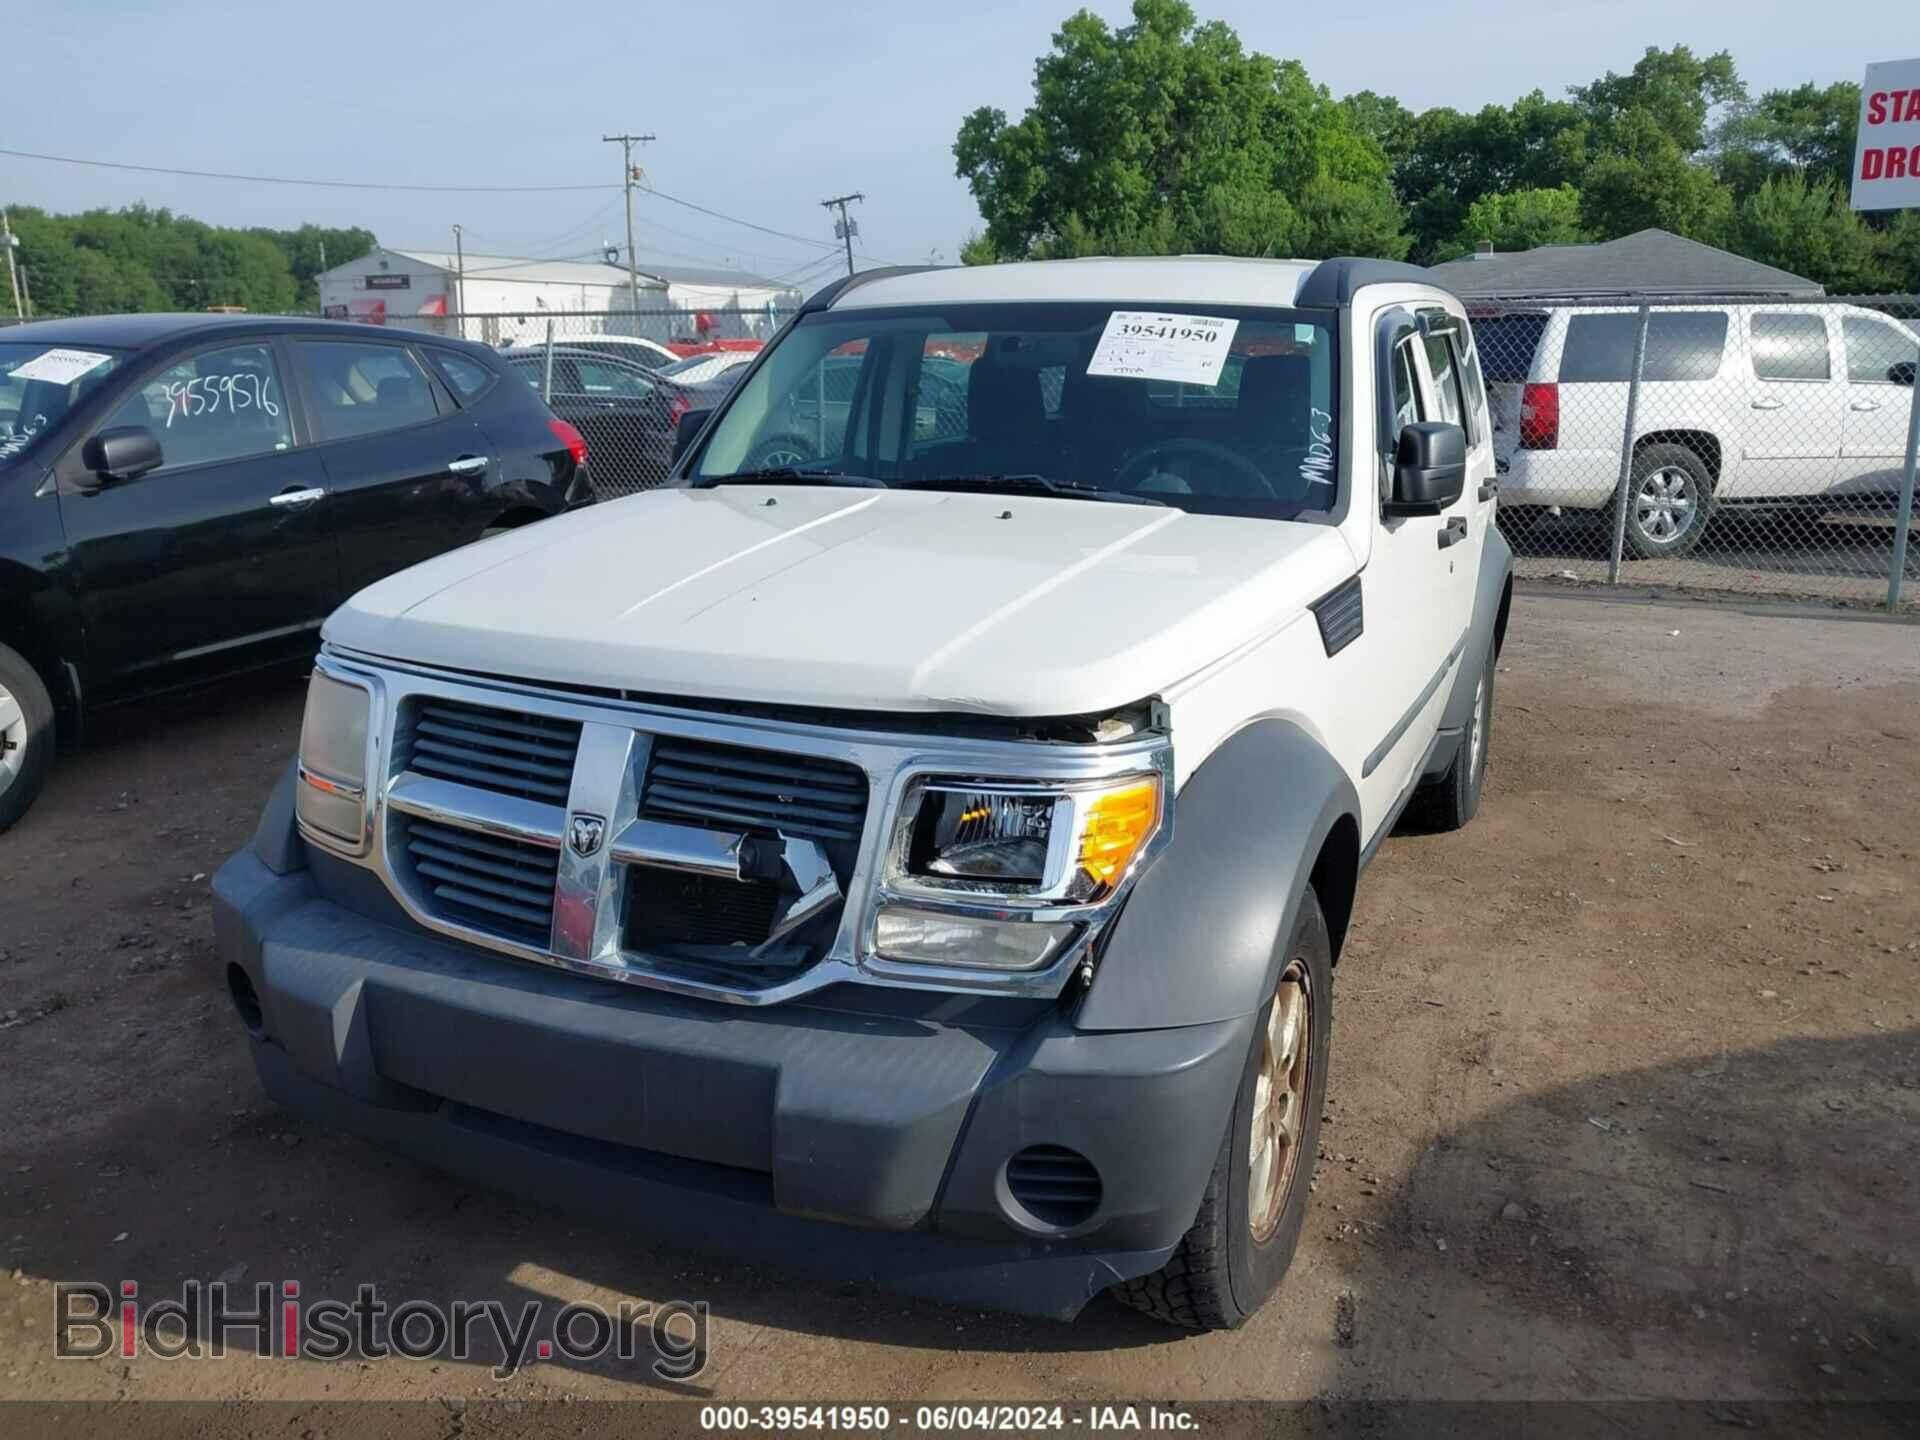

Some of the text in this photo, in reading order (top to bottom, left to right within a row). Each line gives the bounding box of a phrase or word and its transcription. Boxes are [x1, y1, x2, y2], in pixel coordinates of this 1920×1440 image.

[1867, 89, 1920, 126] STA
[1116, 324, 1217, 343] 39541950
[161, 374, 279, 428] 39559576
